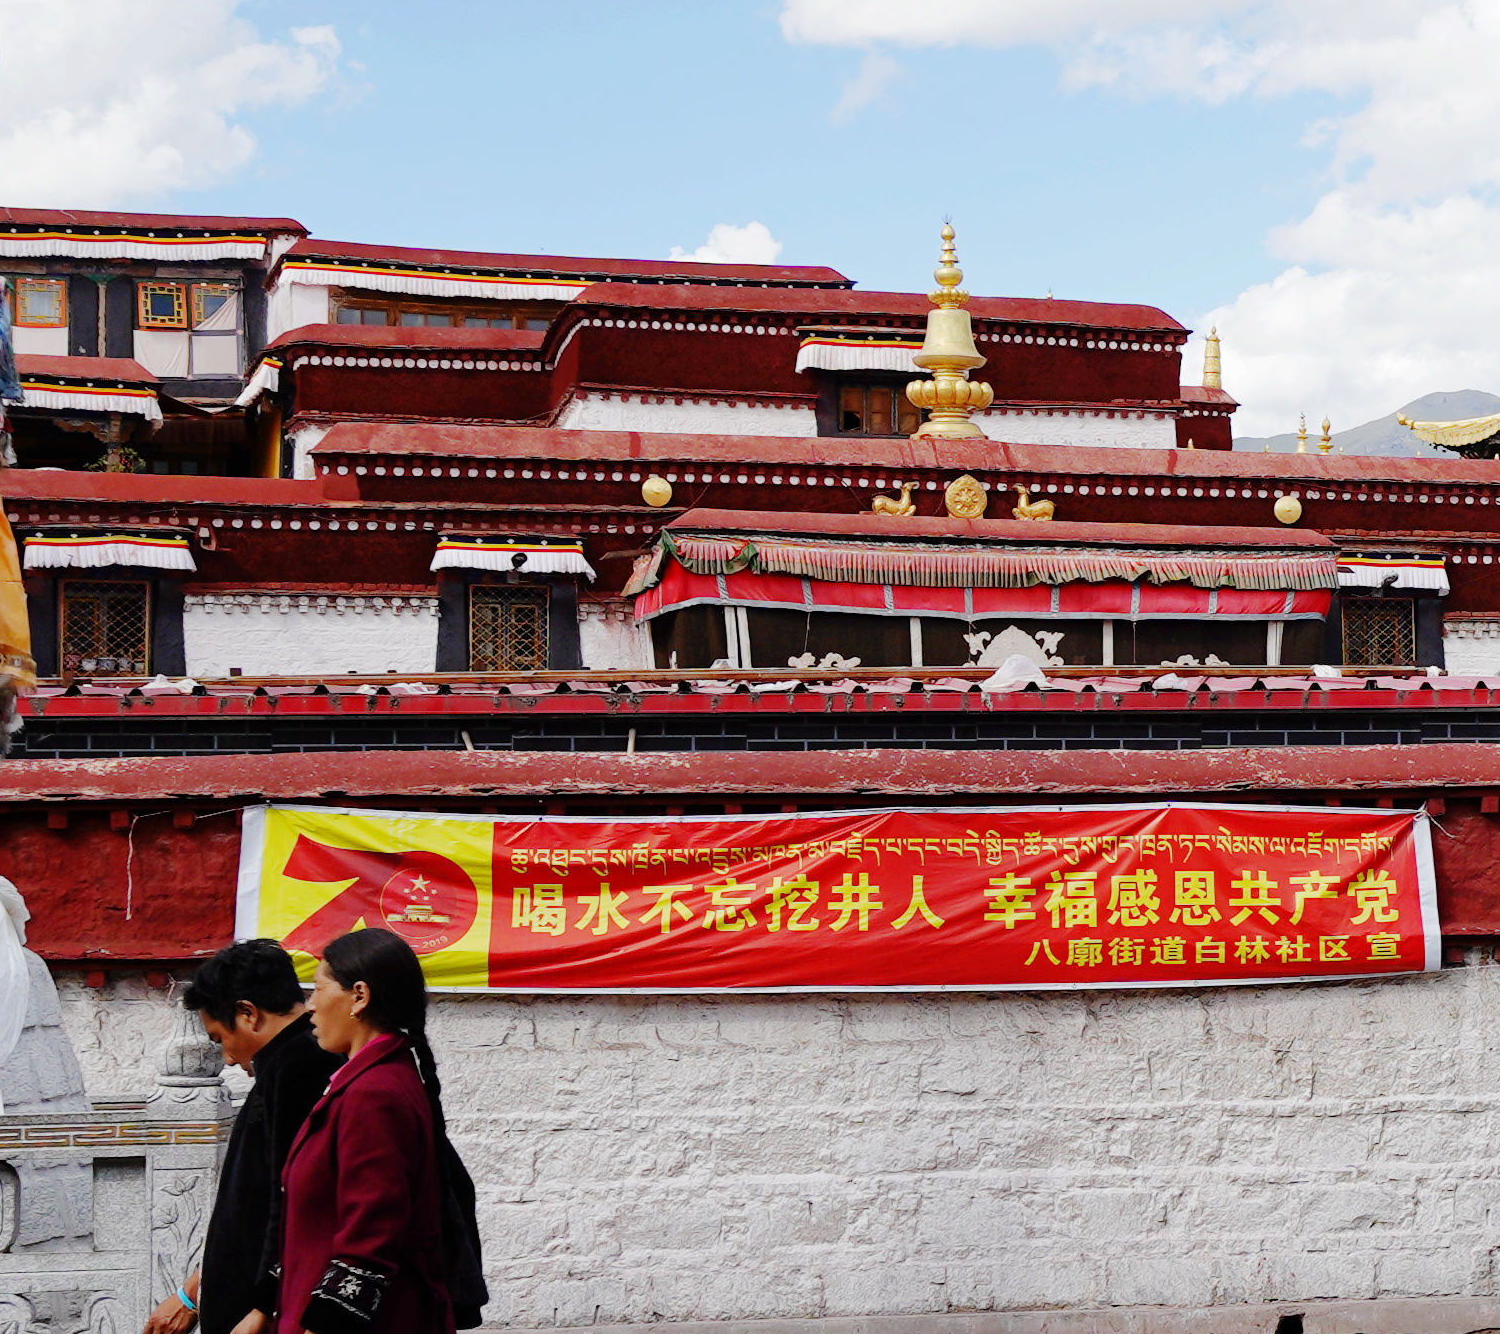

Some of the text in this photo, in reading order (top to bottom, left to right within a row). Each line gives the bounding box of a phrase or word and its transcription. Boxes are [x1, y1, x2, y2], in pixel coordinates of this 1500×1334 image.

[511, 869, 1400, 936] 喝水不忘挖井人 幸福感恩共产党
[1024, 932, 1402, 967] 八廓街道白林社区 宣
